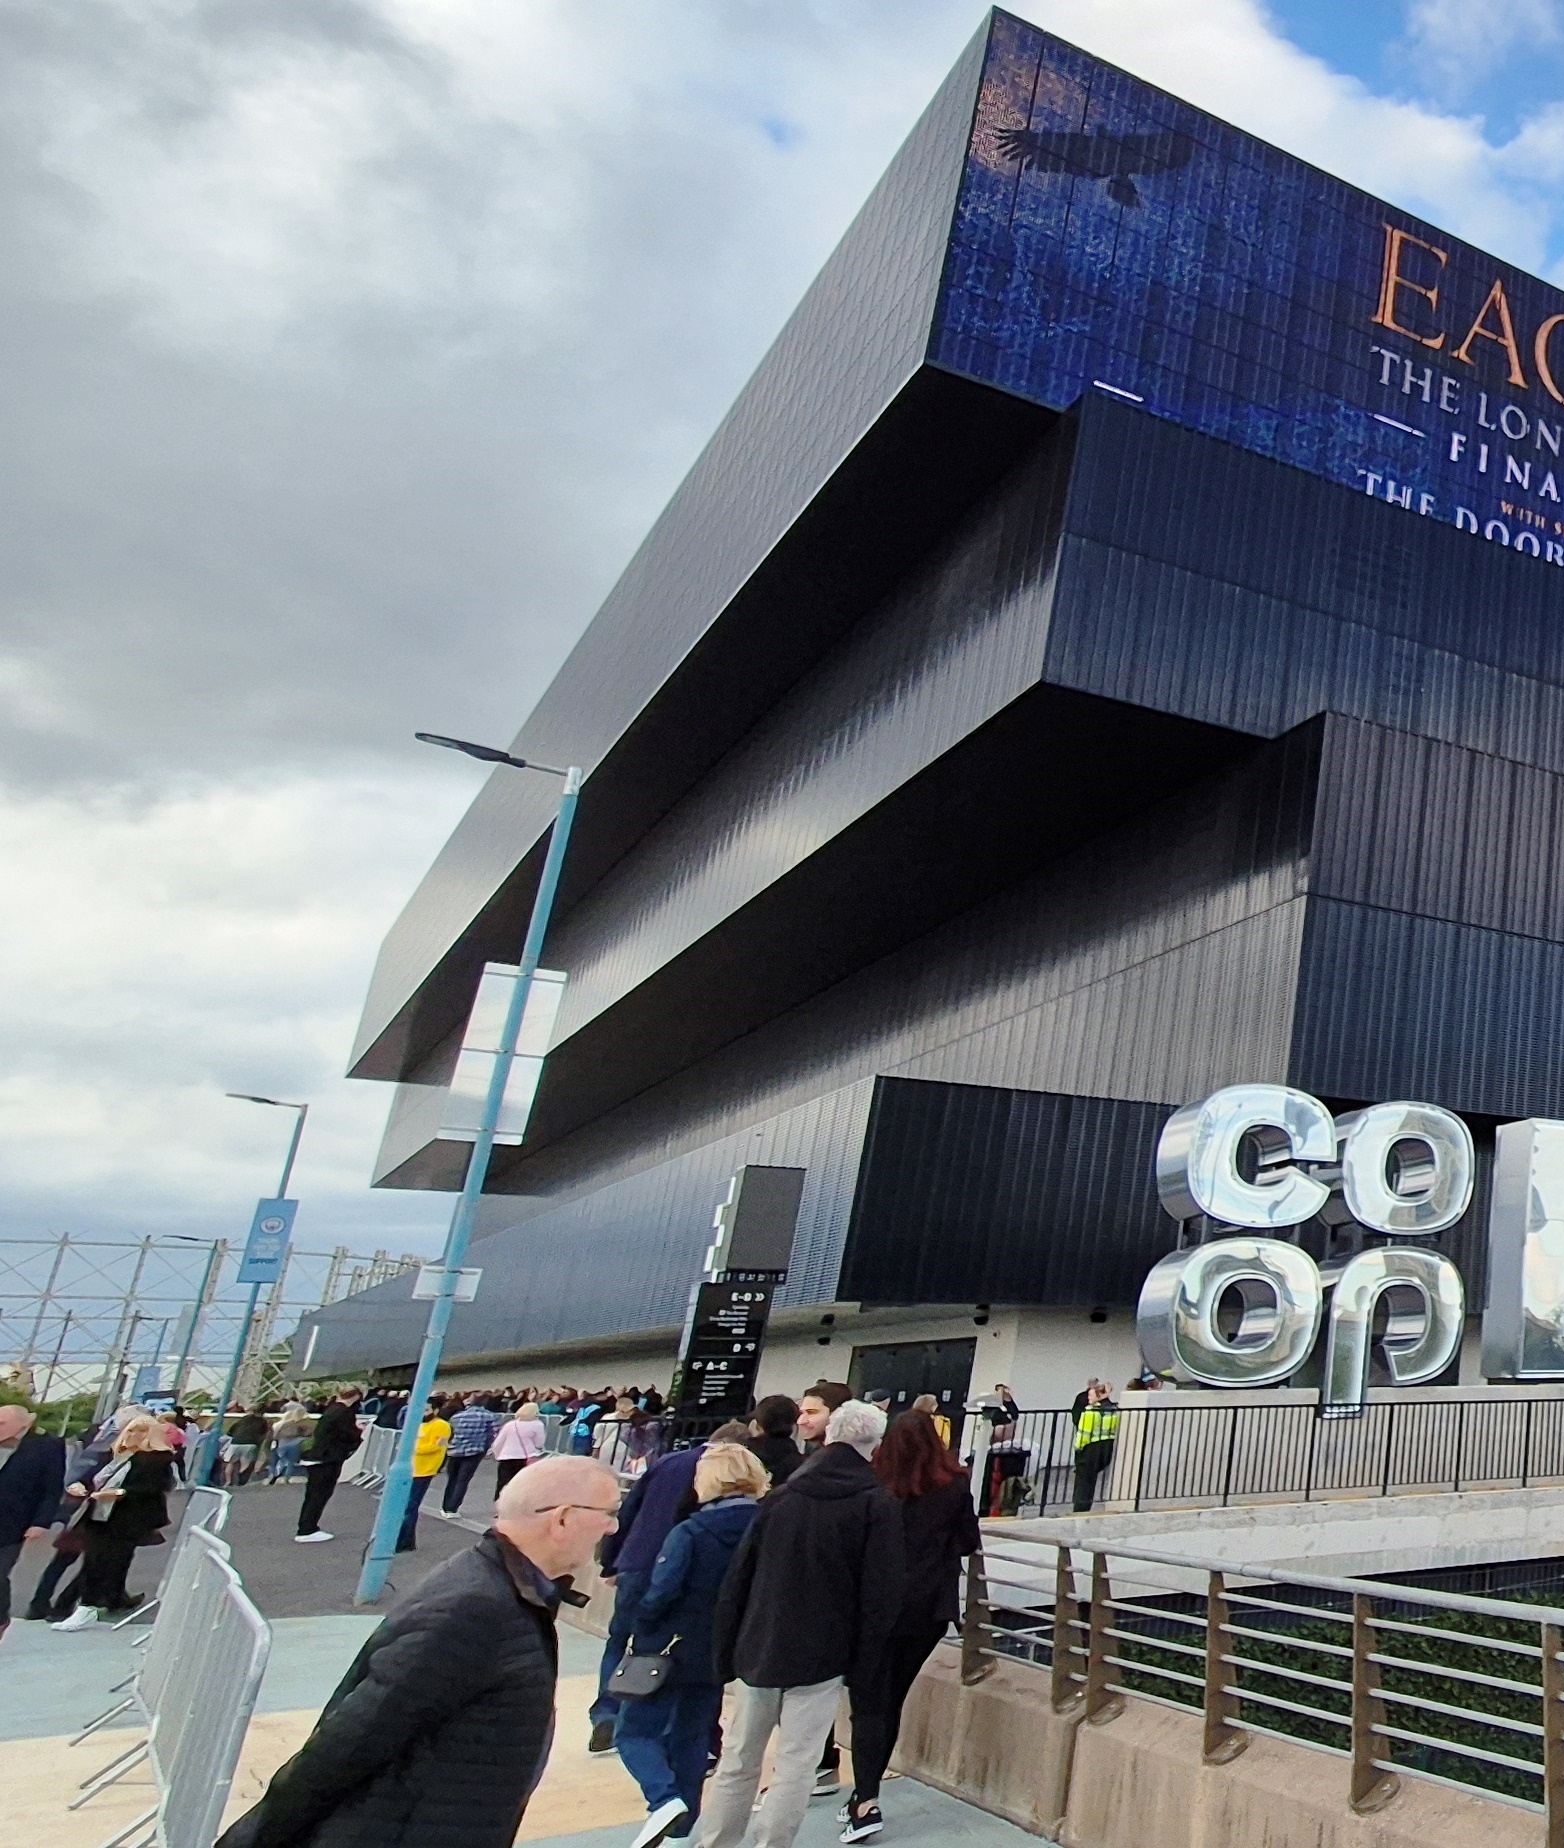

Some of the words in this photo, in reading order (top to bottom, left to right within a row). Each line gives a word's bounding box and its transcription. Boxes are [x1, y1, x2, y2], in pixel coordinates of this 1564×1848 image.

[1370, 345, 1460, 415] THE
[1356, 468, 1436, 516] THE
[1500, 499, 1546, 530] WITH
